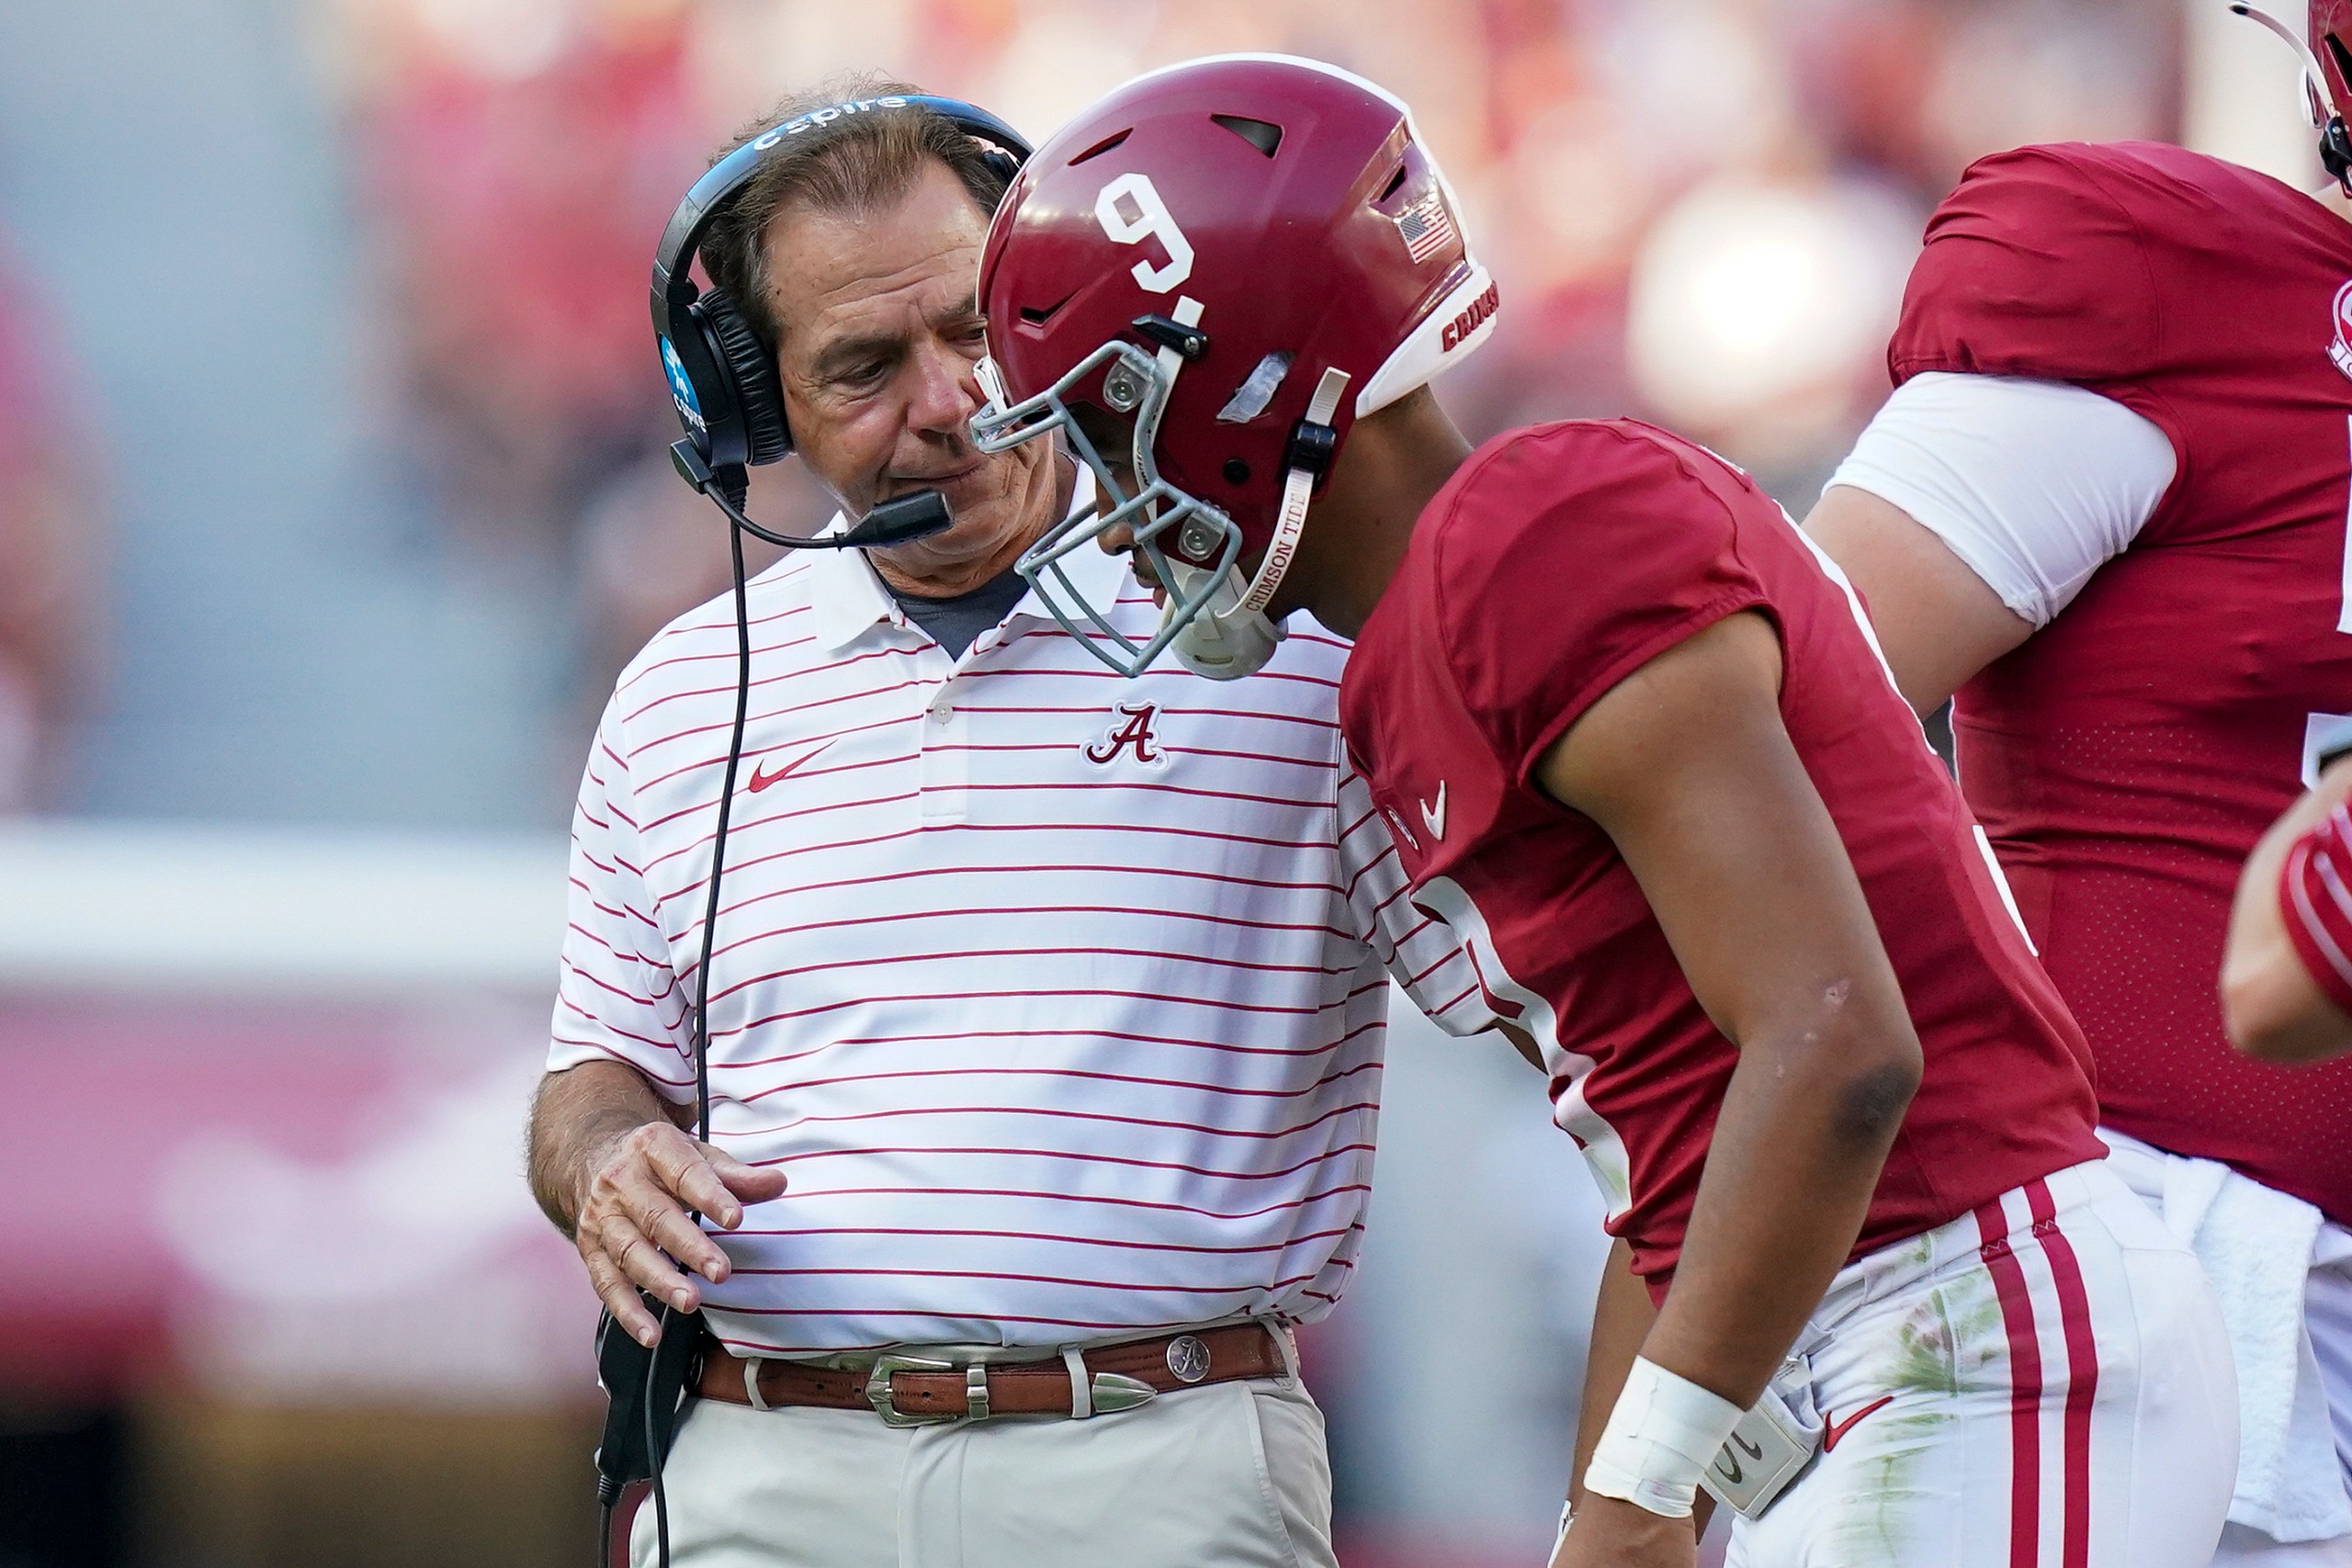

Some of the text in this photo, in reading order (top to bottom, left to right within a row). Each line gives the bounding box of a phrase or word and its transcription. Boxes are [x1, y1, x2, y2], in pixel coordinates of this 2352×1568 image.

[1093, 172, 1195, 295] 9
[1245, 492, 1306, 613] CRIMSON TIDE
[1086, 705, 1158, 764] A
